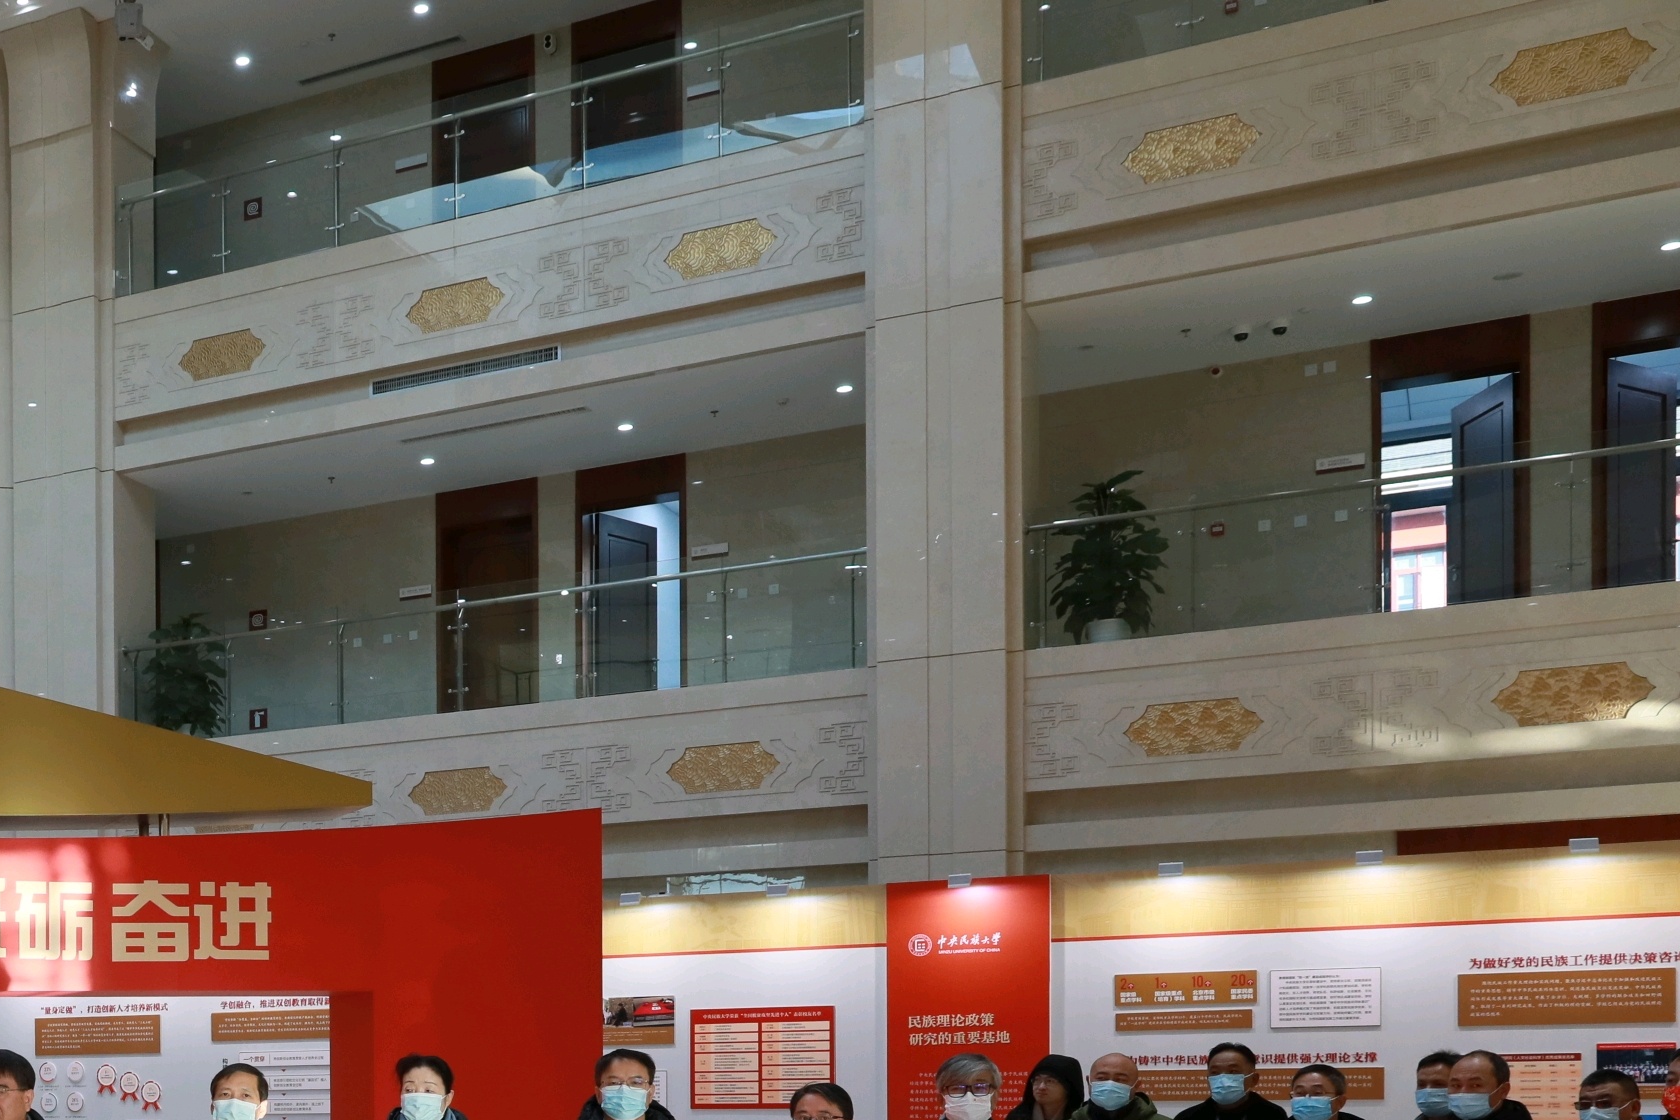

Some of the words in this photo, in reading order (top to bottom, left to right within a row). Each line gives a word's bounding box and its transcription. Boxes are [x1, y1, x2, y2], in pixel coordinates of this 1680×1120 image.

[937, 932, 1001, 949] 中央民族大学
[40, 1003, 169, 1015] “量身定做”，打造创新人才培养新模式
[908, 1013, 995, 1028] 民族理论政策
[909, 1030, 1011, 1046] 研究的重要基地
